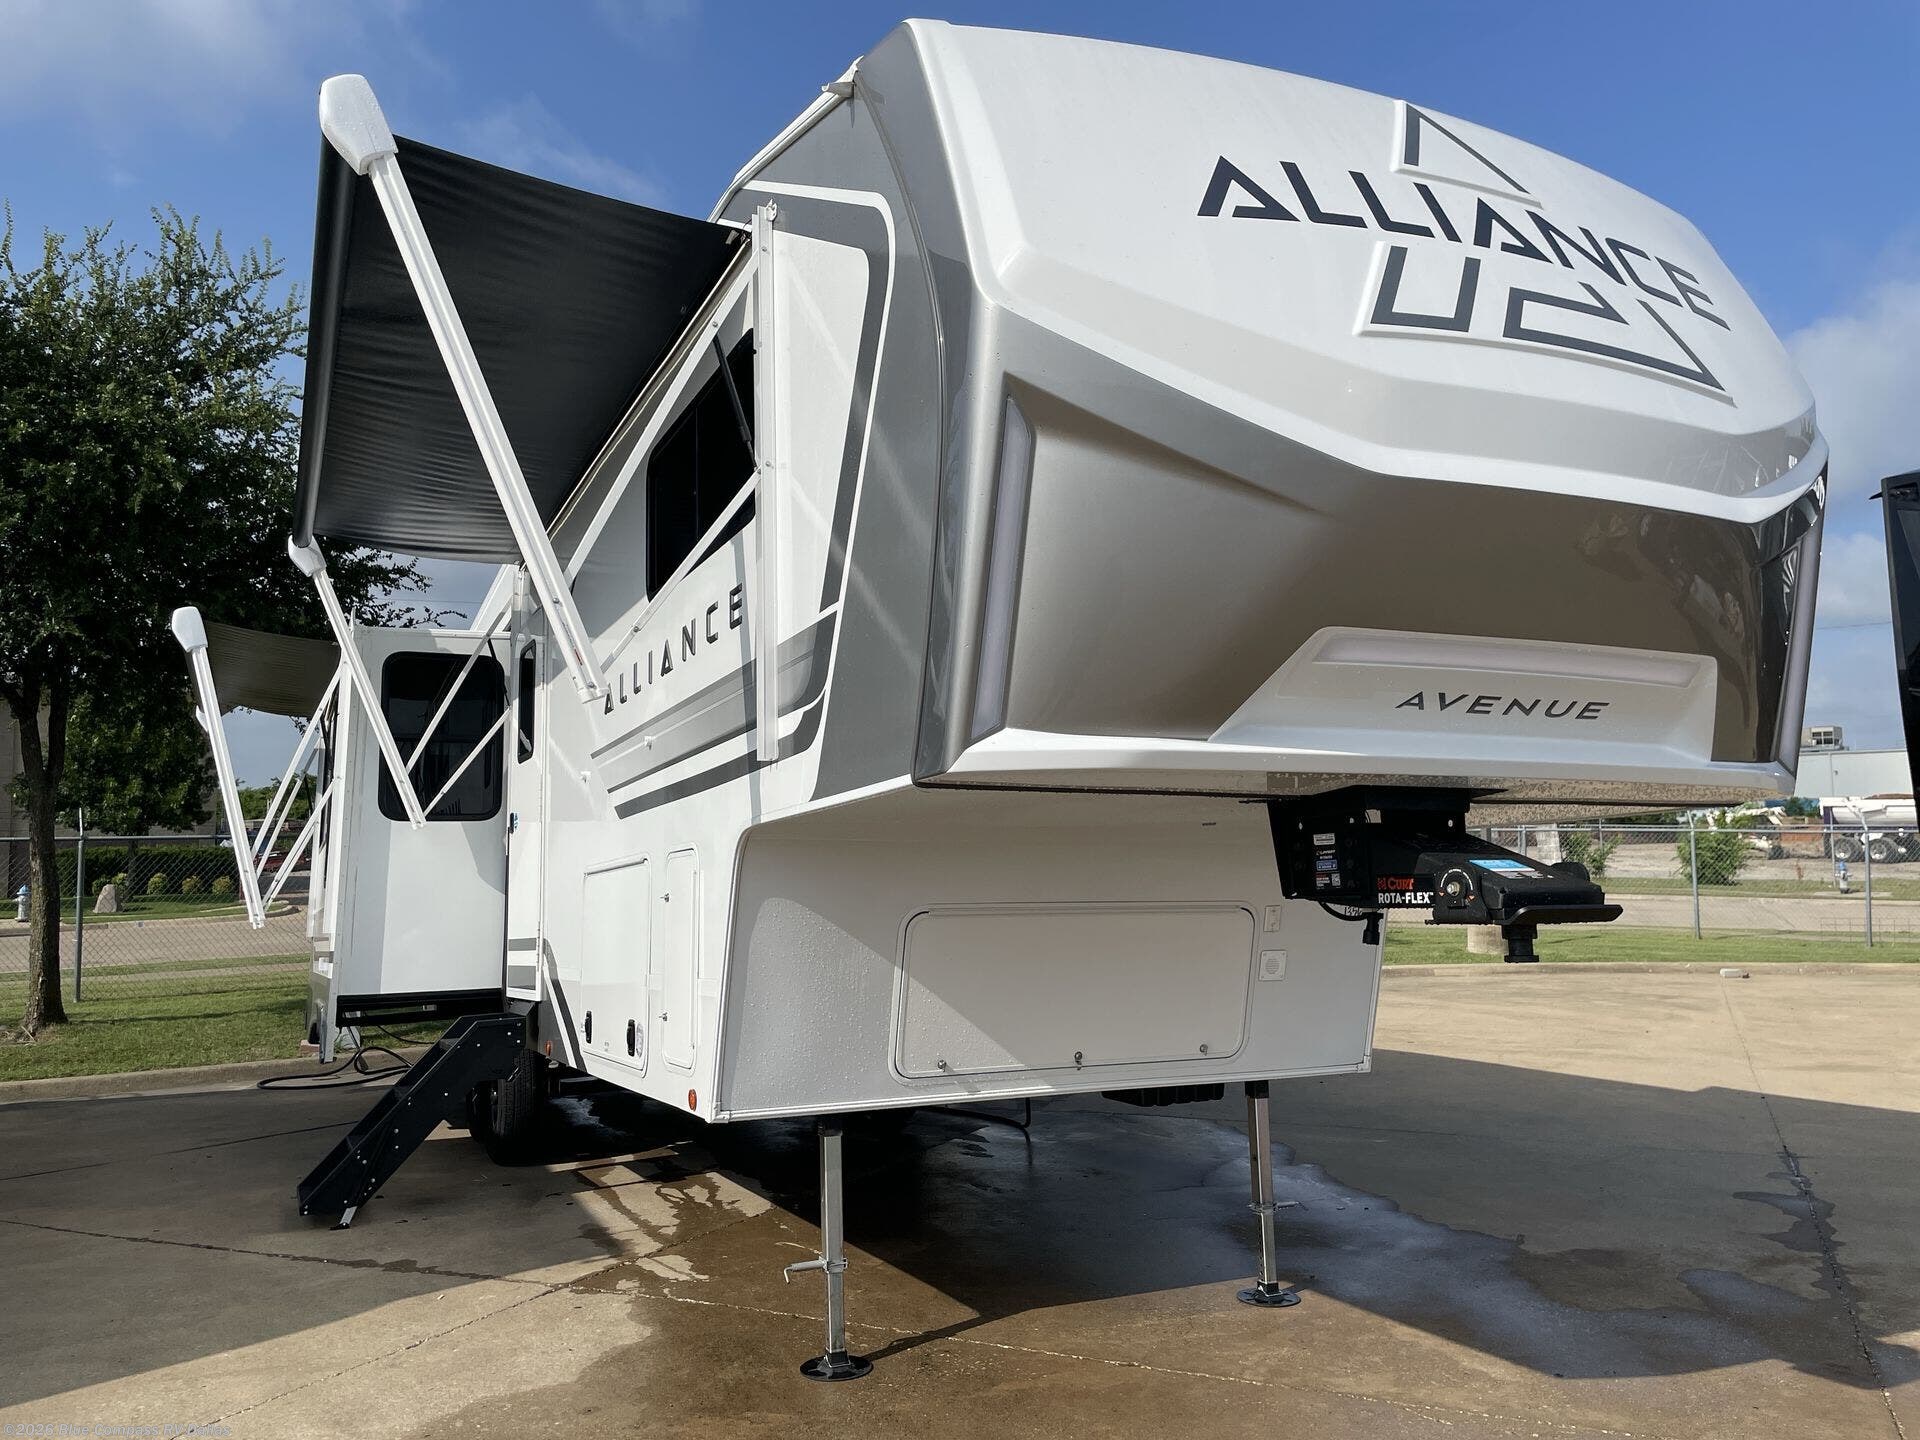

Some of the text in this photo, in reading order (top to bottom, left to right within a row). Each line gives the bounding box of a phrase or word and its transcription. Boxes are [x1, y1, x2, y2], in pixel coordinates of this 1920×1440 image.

[1197, 154, 1731, 331] ALLIANCE
[604, 582, 743, 715] ALLIANCE
[1395, 690, 1610, 720] AVENUE
